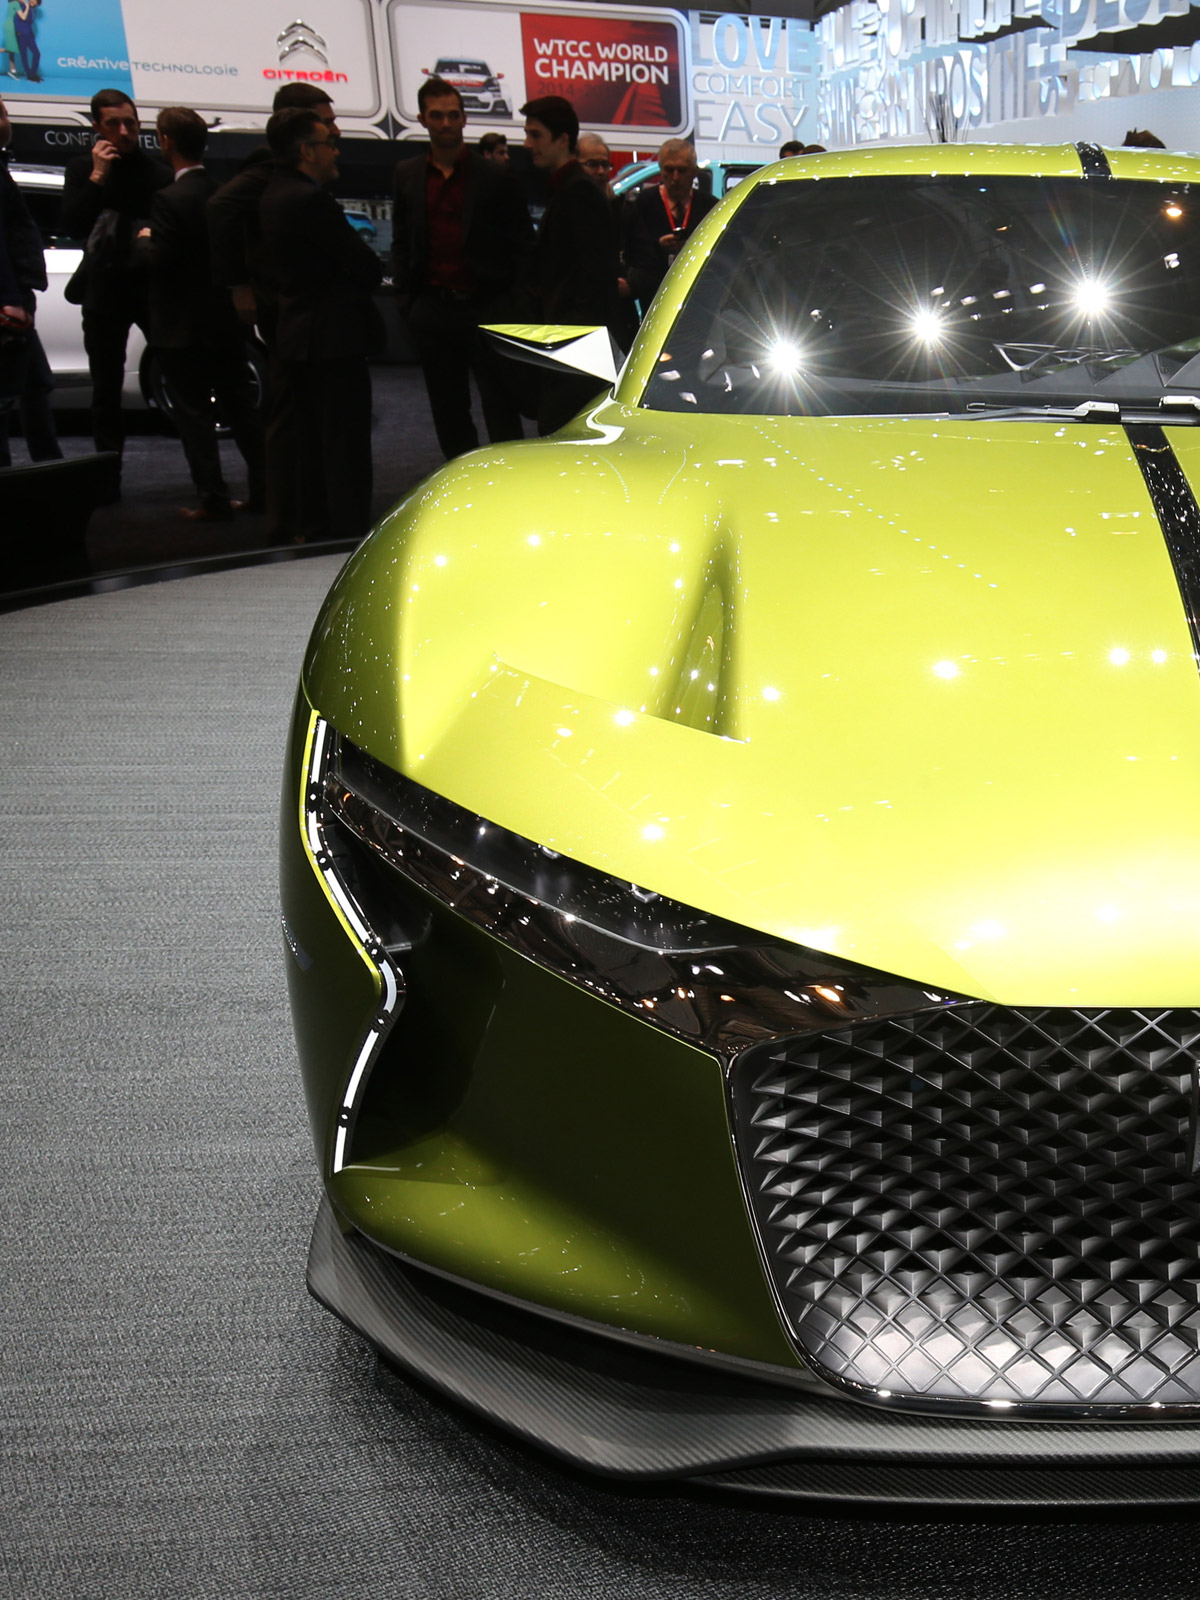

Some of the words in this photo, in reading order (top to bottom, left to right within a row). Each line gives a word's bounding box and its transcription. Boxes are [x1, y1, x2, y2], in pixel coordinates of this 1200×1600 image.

[533, 37, 592, 58] WTCC
[596, 41, 669, 63] WORLD
[689, 10, 812, 75] LOVE
[534, 57, 670, 86] CHAMPION
[693, 72, 806, 101] COMFORT
[694, 99, 810, 144] EASY
